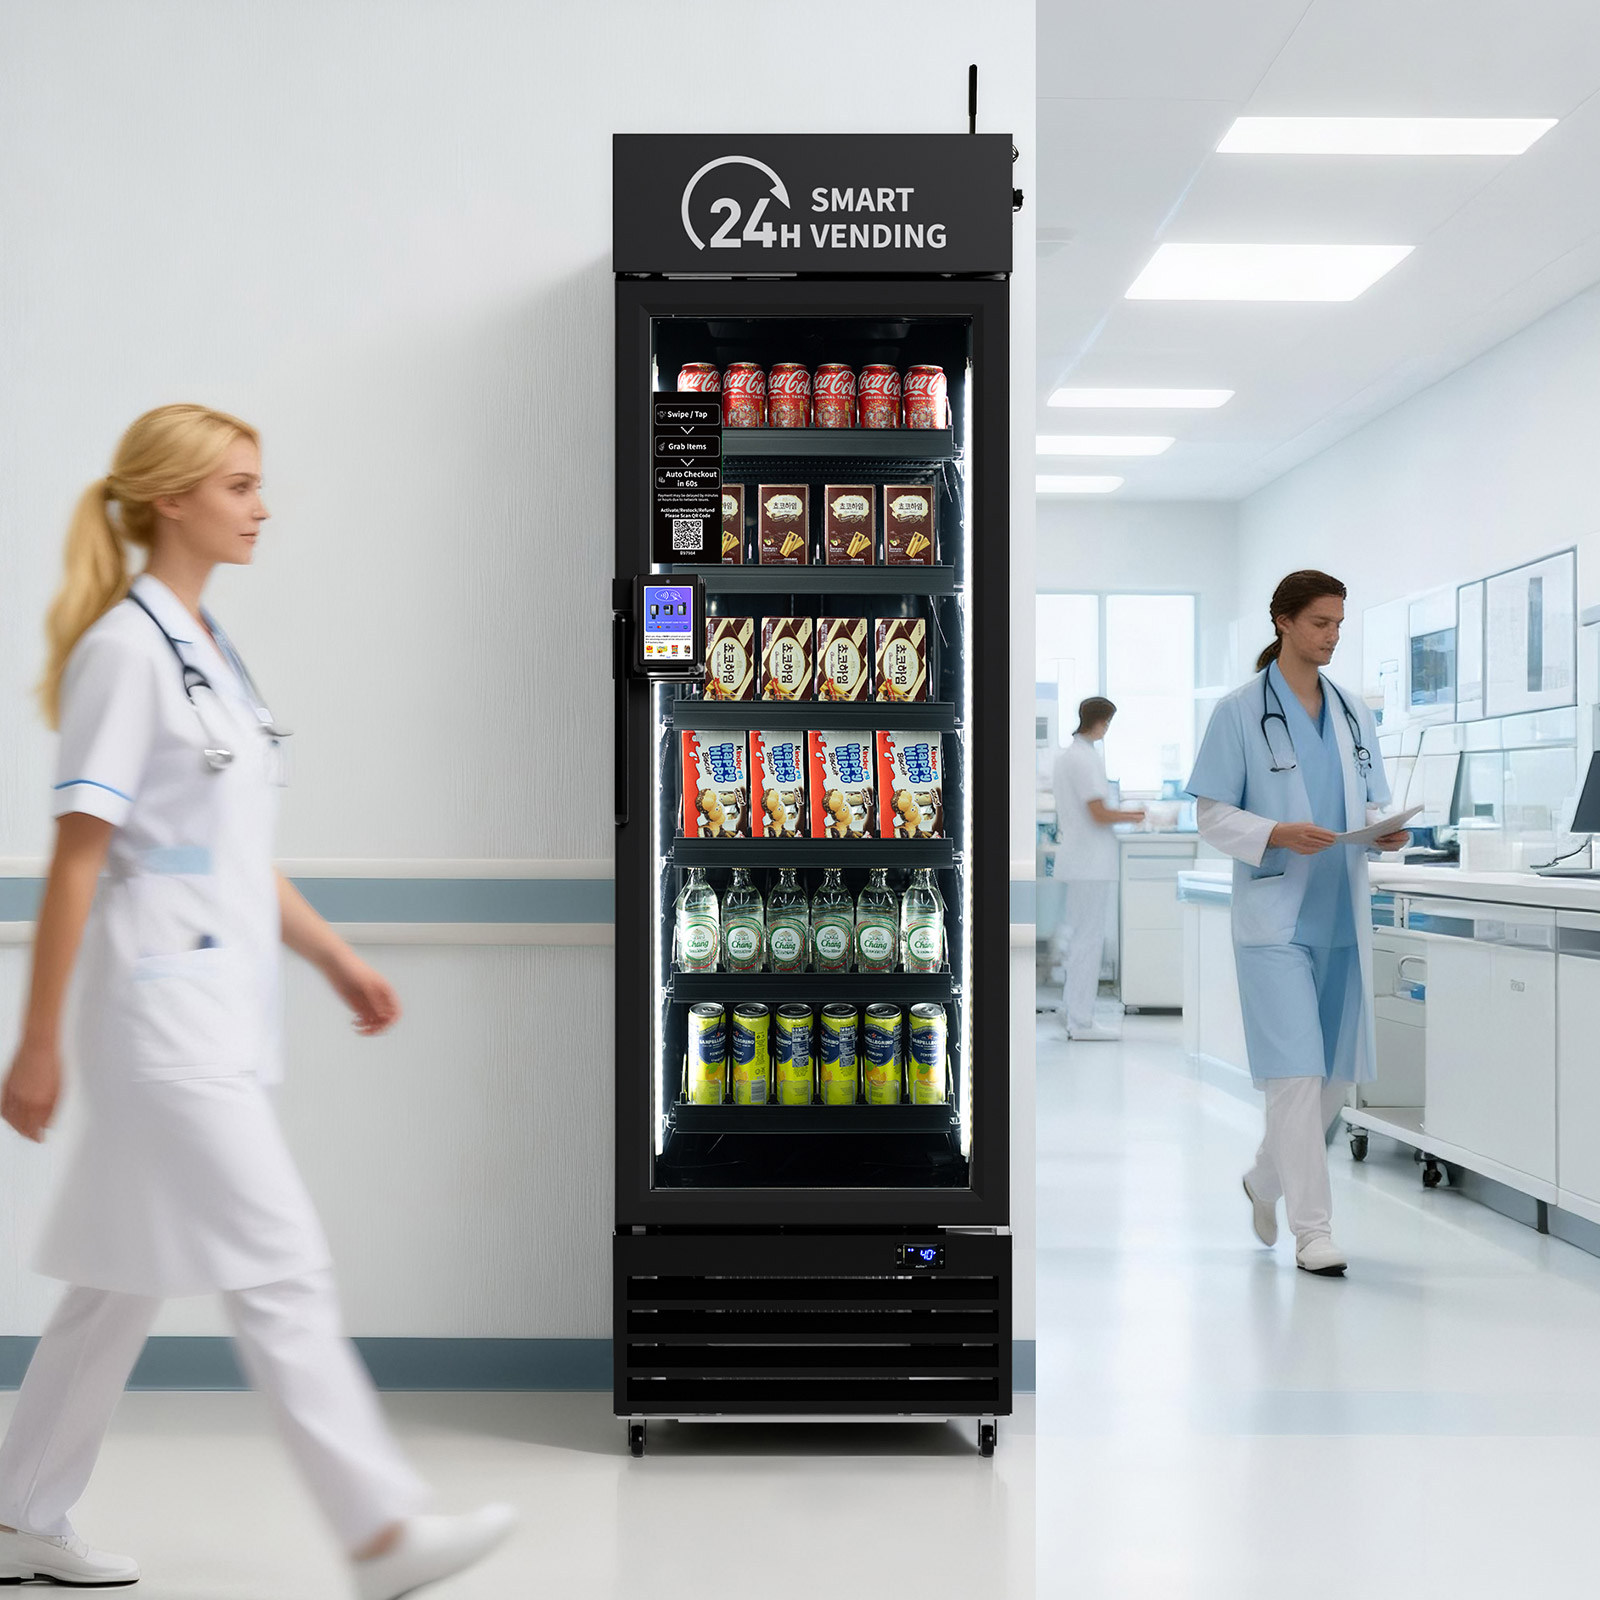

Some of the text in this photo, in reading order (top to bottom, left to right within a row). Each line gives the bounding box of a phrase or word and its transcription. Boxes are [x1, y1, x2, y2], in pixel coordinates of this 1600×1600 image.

[811, 187, 914, 212] SMART
[710, 198, 801, 248] 24H
[810, 223, 947, 249] VENDING
[667, 410, 690, 419] Swipe
[694, 410, 708, 419] Tap
[722, 643, 735, 683] 초코하임
[782, 643, 793, 683] 초코하임
[837, 644, 848, 684] 초코하임
[895, 644, 907, 684] 초코하임
[709, 746, 724, 783] Hippo
[721, 743, 736, 782] Happy
[772, 746, 786, 783] Hippo
[782, 743, 796, 782] Happy
[835, 746, 852, 783] Hippo
[847, 743, 863, 782] Happy
[904, 746, 920, 783] Hippo
[915, 743, 932, 782] Happy
[687, 940, 709, 948] Chang
[732, 940, 752, 949] Chang
[775, 941, 796, 950] Chang
[821, 940, 841, 949] Chang
[864, 940, 887, 950] Chang
